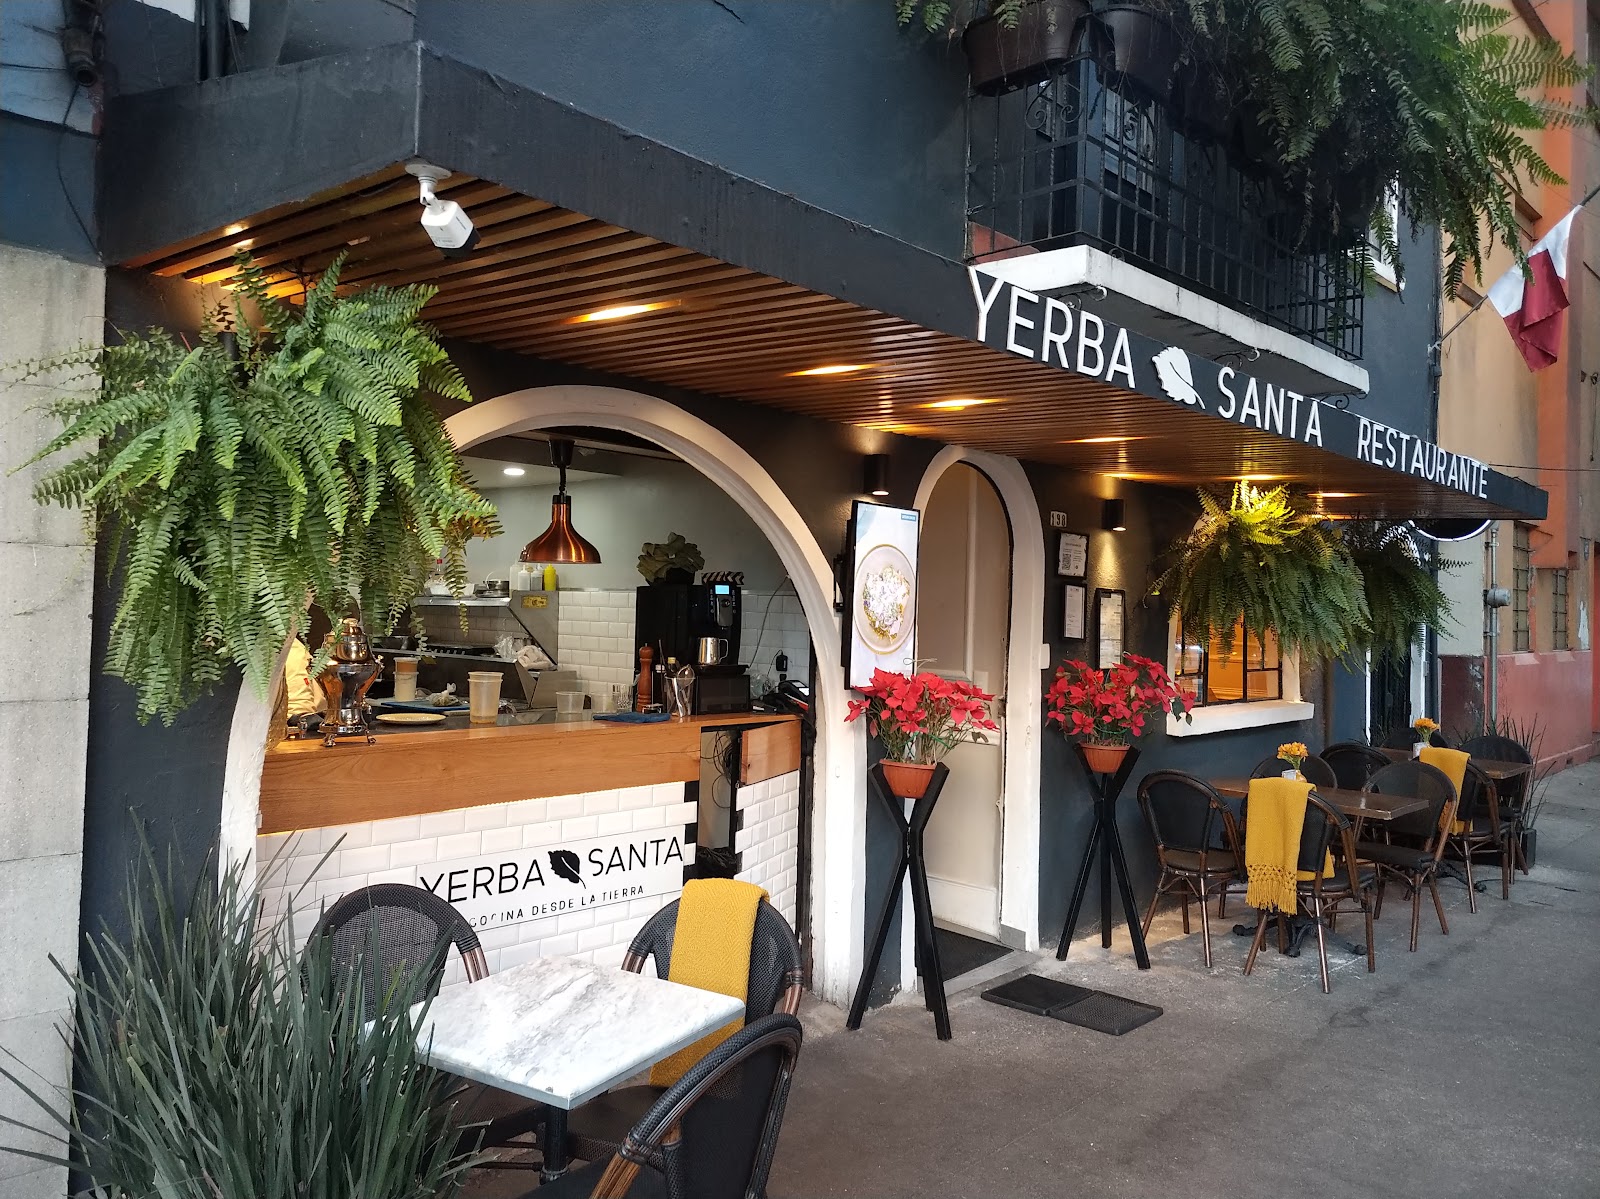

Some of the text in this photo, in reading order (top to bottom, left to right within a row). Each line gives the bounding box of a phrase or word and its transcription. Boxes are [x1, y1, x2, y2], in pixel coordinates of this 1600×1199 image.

[968, 266, 1489, 499] YERBA SANTA RESTAURANTE
[419, 836, 684, 903] YERBA SANTA
[531, 898, 575, 916] DESDE
[581, 894, 596, 906] LA
[602, 885, 644, 901] TIERRA
